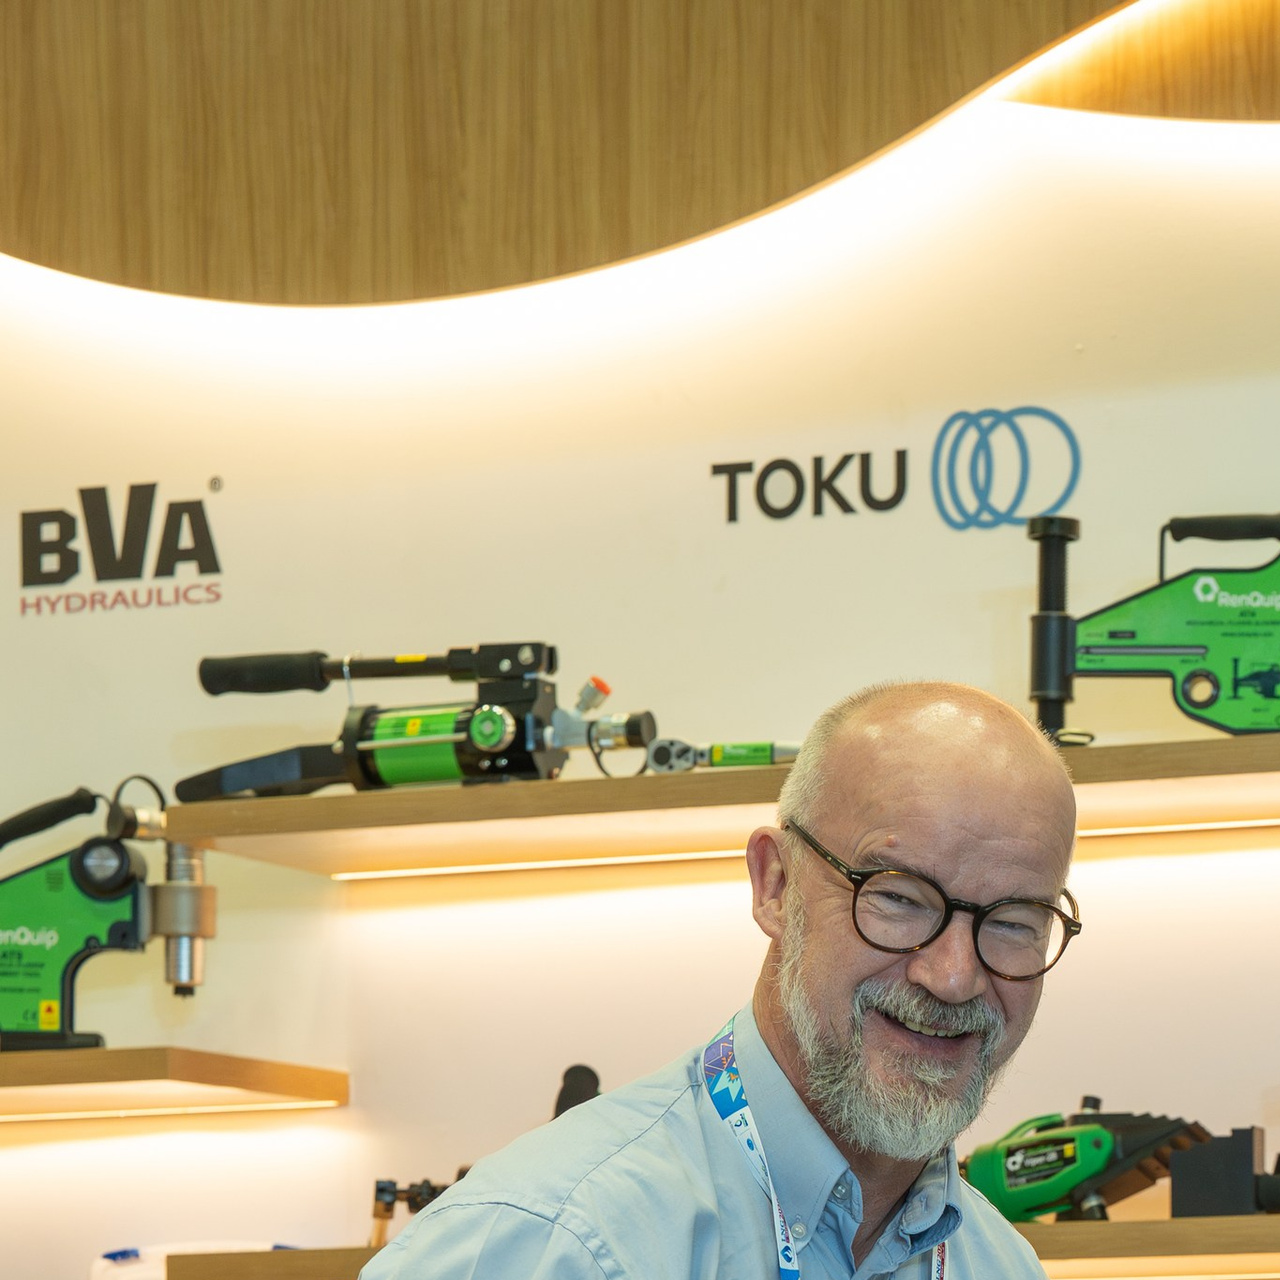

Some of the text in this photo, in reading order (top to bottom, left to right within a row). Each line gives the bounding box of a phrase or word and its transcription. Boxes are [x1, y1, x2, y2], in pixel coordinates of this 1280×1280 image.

[712, 449, 907, 522] TOKU
[21, 482, 222, 588] BVA
[20, 583, 222, 616] HYDRAULICS
